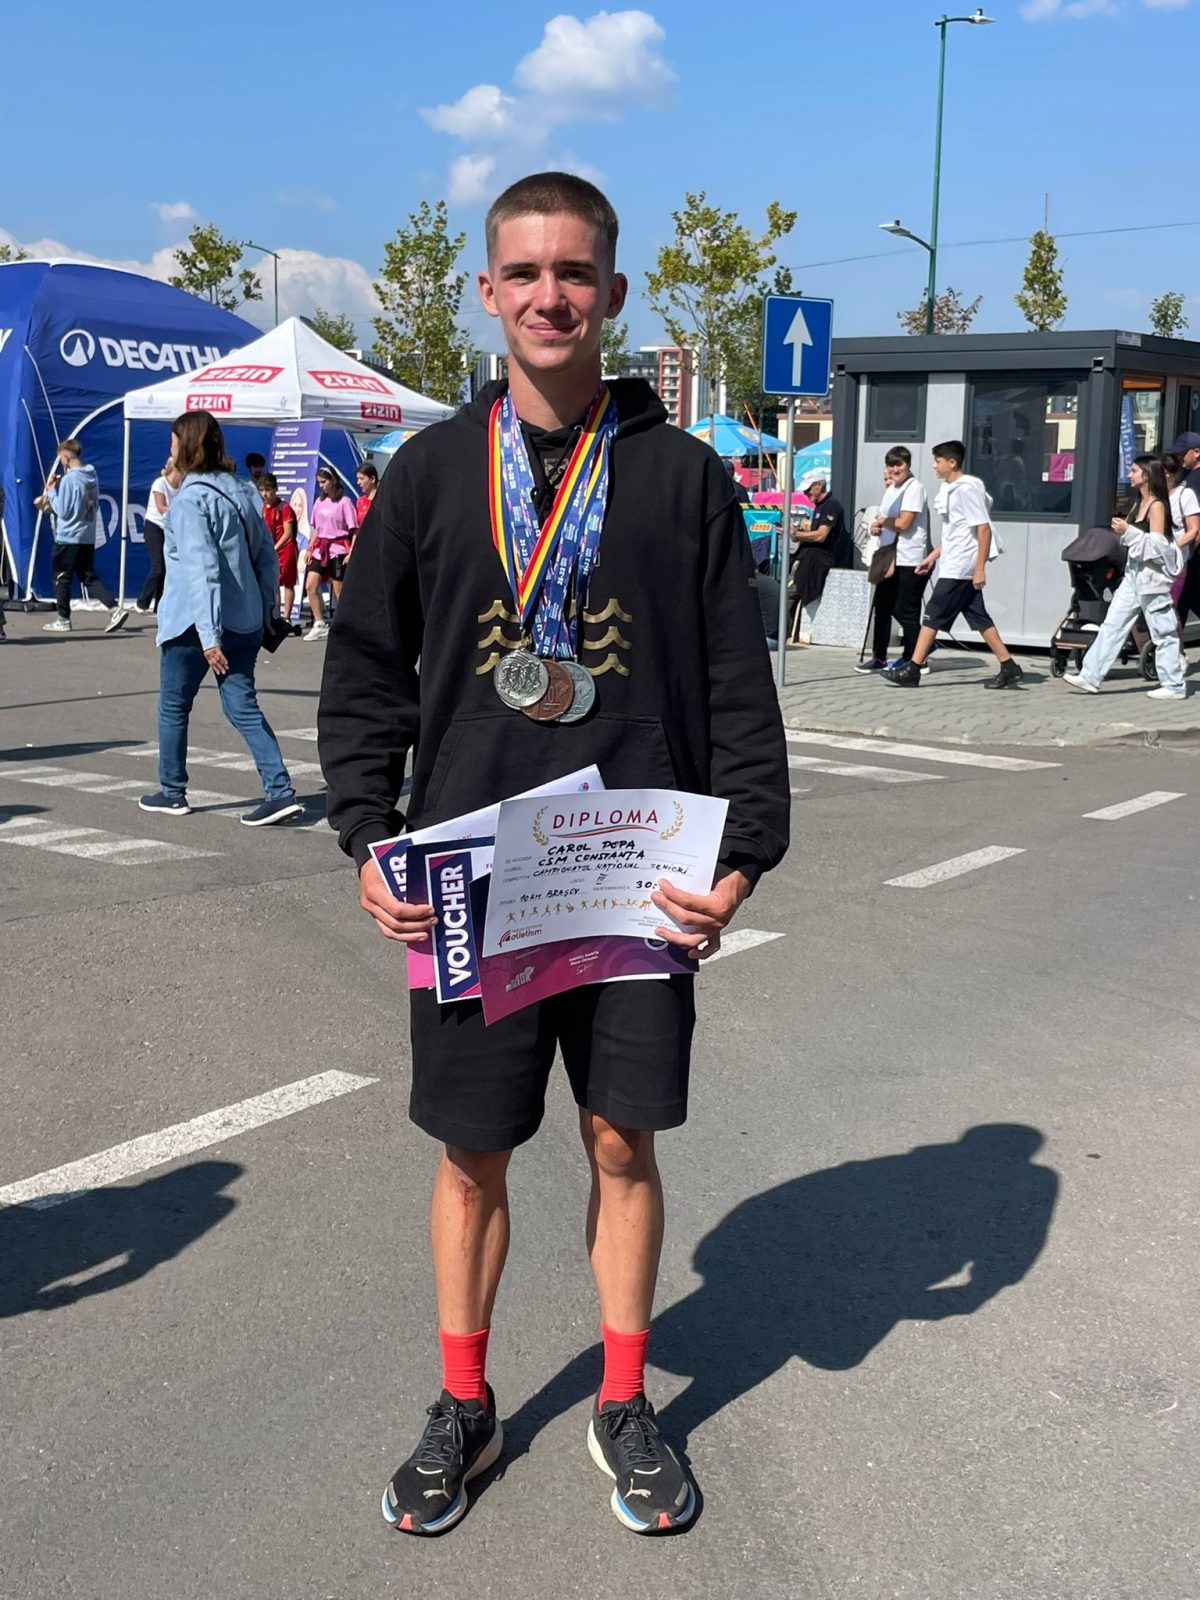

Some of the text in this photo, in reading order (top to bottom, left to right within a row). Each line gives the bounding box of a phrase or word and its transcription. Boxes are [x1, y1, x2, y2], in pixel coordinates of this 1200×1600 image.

[98, 337, 236, 373] DECATH
[552, 809, 658, 829] DIPLOMA
[547, 840, 635, 856] CAROL POPA
[538, 855, 568, 867] CSM
[532, 865, 592, 877] CAMPIONATUL
[635, 880, 658, 890] 30:
[440, 864, 473, 987] VOUCHER
